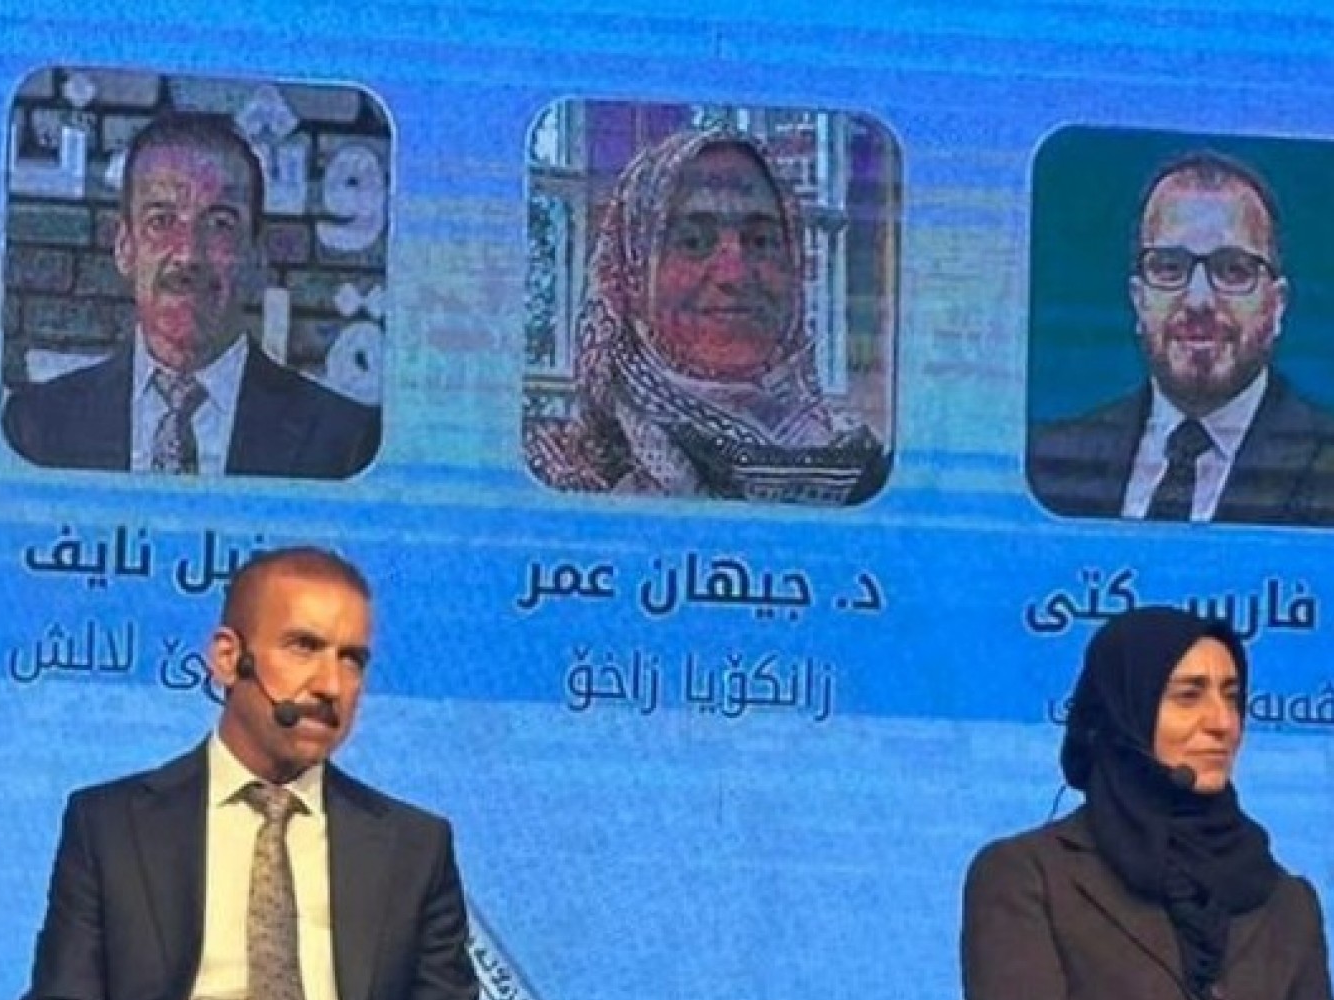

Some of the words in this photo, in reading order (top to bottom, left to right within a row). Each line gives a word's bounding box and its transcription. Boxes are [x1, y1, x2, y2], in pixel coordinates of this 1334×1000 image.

[516, 562, 615, 610] عمر
[835, 572, 882, 610] د.
[9, 619, 135, 682] لالش
